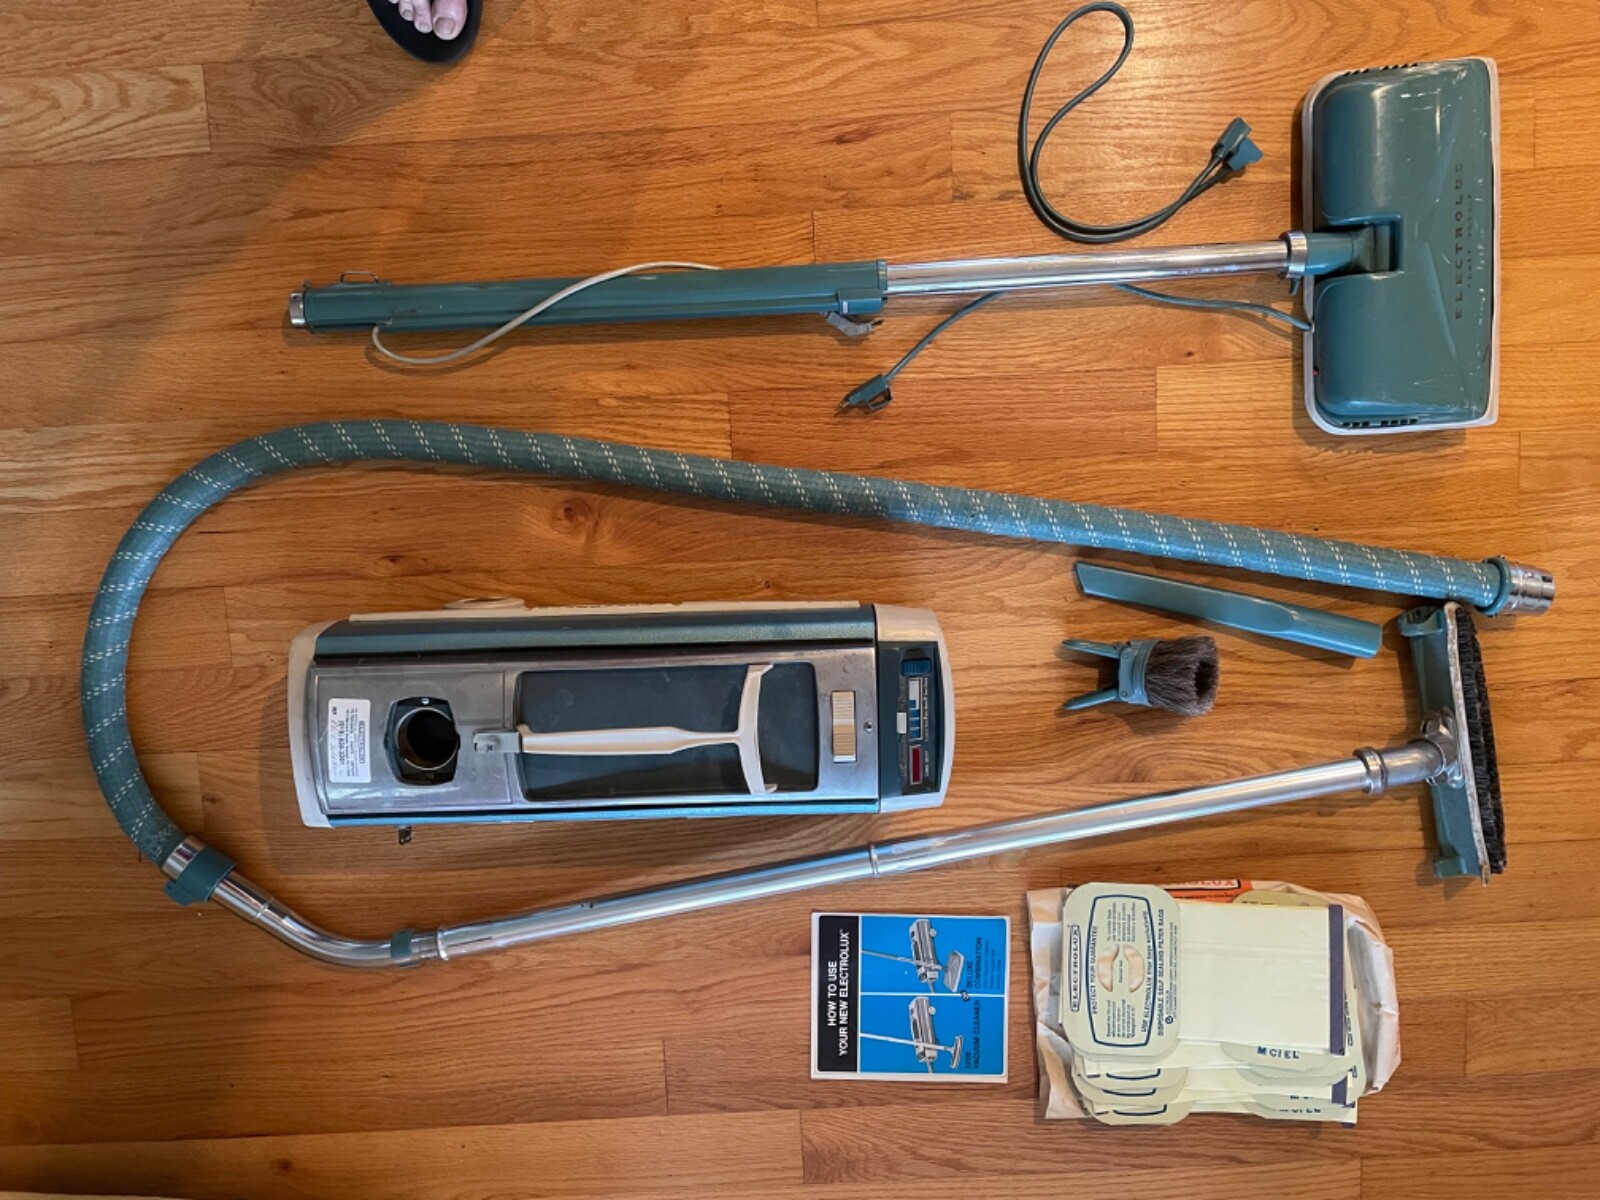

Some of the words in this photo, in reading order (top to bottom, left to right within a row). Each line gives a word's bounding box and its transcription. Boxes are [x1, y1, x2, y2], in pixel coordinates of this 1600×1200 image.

[1454, 163, 1463, 320] ELECTROLUX
[1090, 926, 1098, 964] GUARANTEE
[827, 961, 837, 981] USE
[966, 960, 974, 989] DELUXE
[974, 938, 982, 989] COMBINATION
[827, 984, 837, 998] TO
[1144, 977, 1152, 1018] ELECTROLUX
[827, 1001, 837, 1026] HOW
[839, 1000, 848, 1024] NEW
[839, 1027, 848, 1056] YOUR
